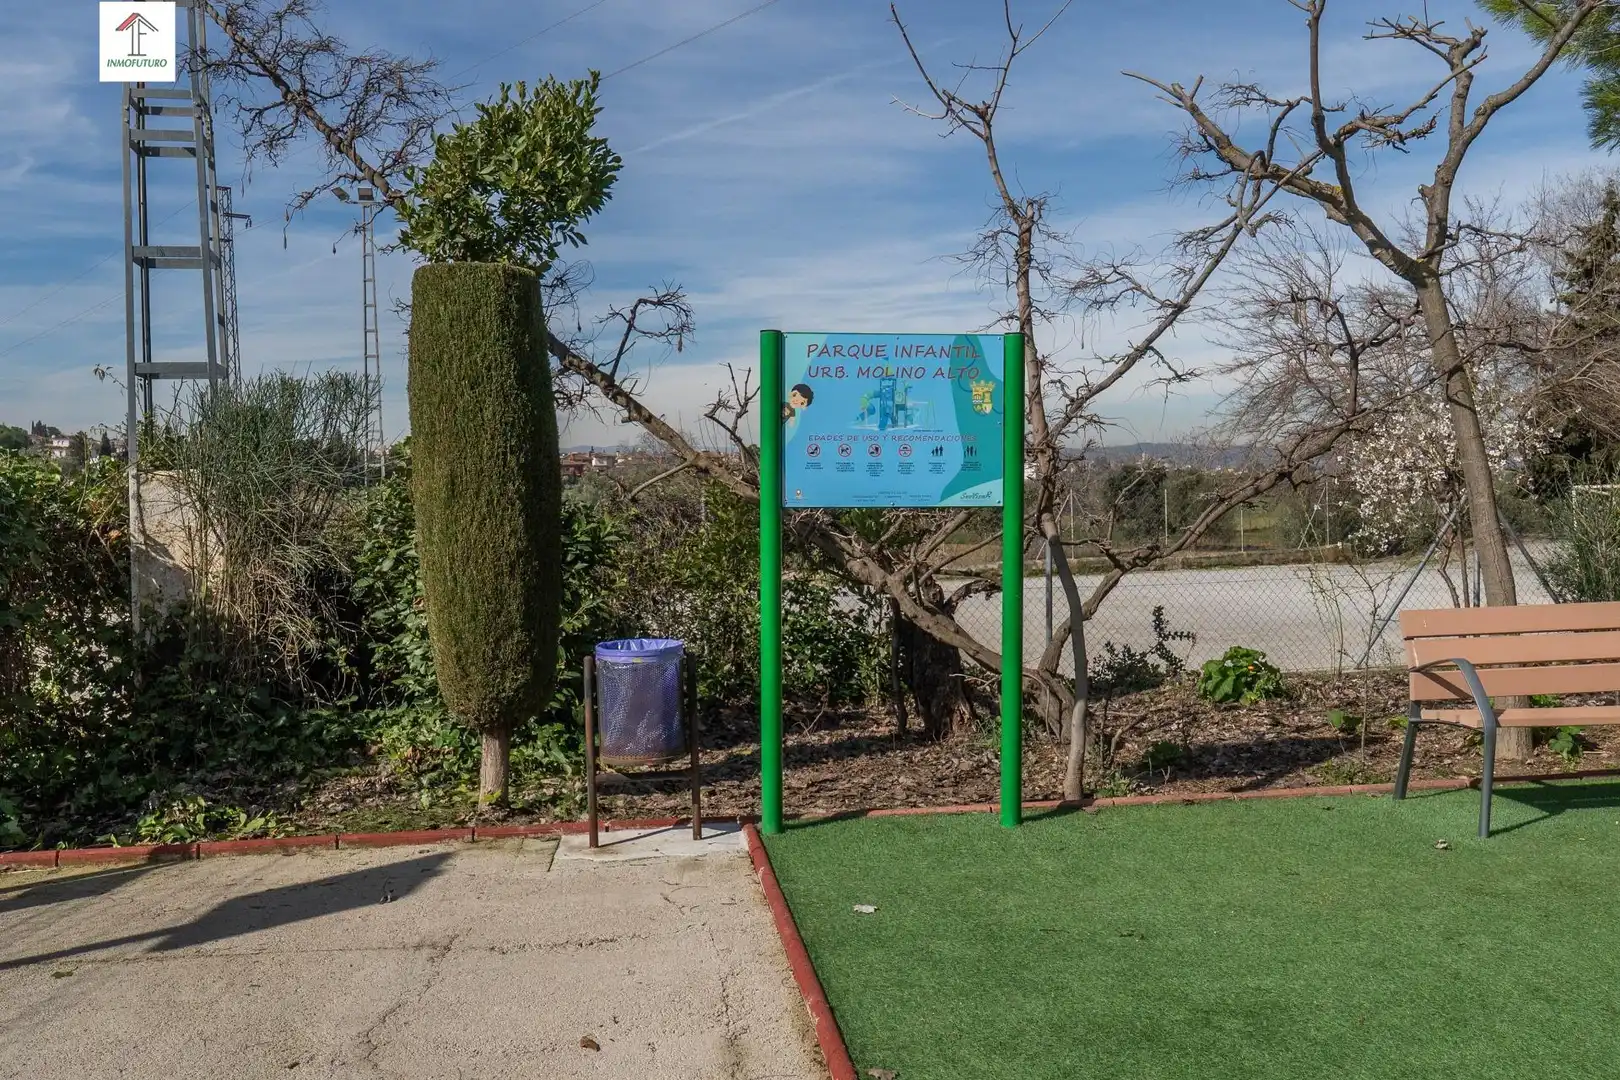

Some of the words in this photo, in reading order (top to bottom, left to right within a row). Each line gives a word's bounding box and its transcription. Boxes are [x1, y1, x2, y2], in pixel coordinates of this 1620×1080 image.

[807, 343, 887, 359] PARQUE
[894, 345, 981, 359] INFANTIL
[808, 366, 849, 379] URB.
[856, 366, 926, 379] MOLINO
[932, 367, 980, 379] ALTO
[808, 434, 843, 442] EDADES
[847, 434, 859, 442] DE
[862, 434, 880, 442] USO
[891, 434, 977, 442] RECOMENDACIONES
